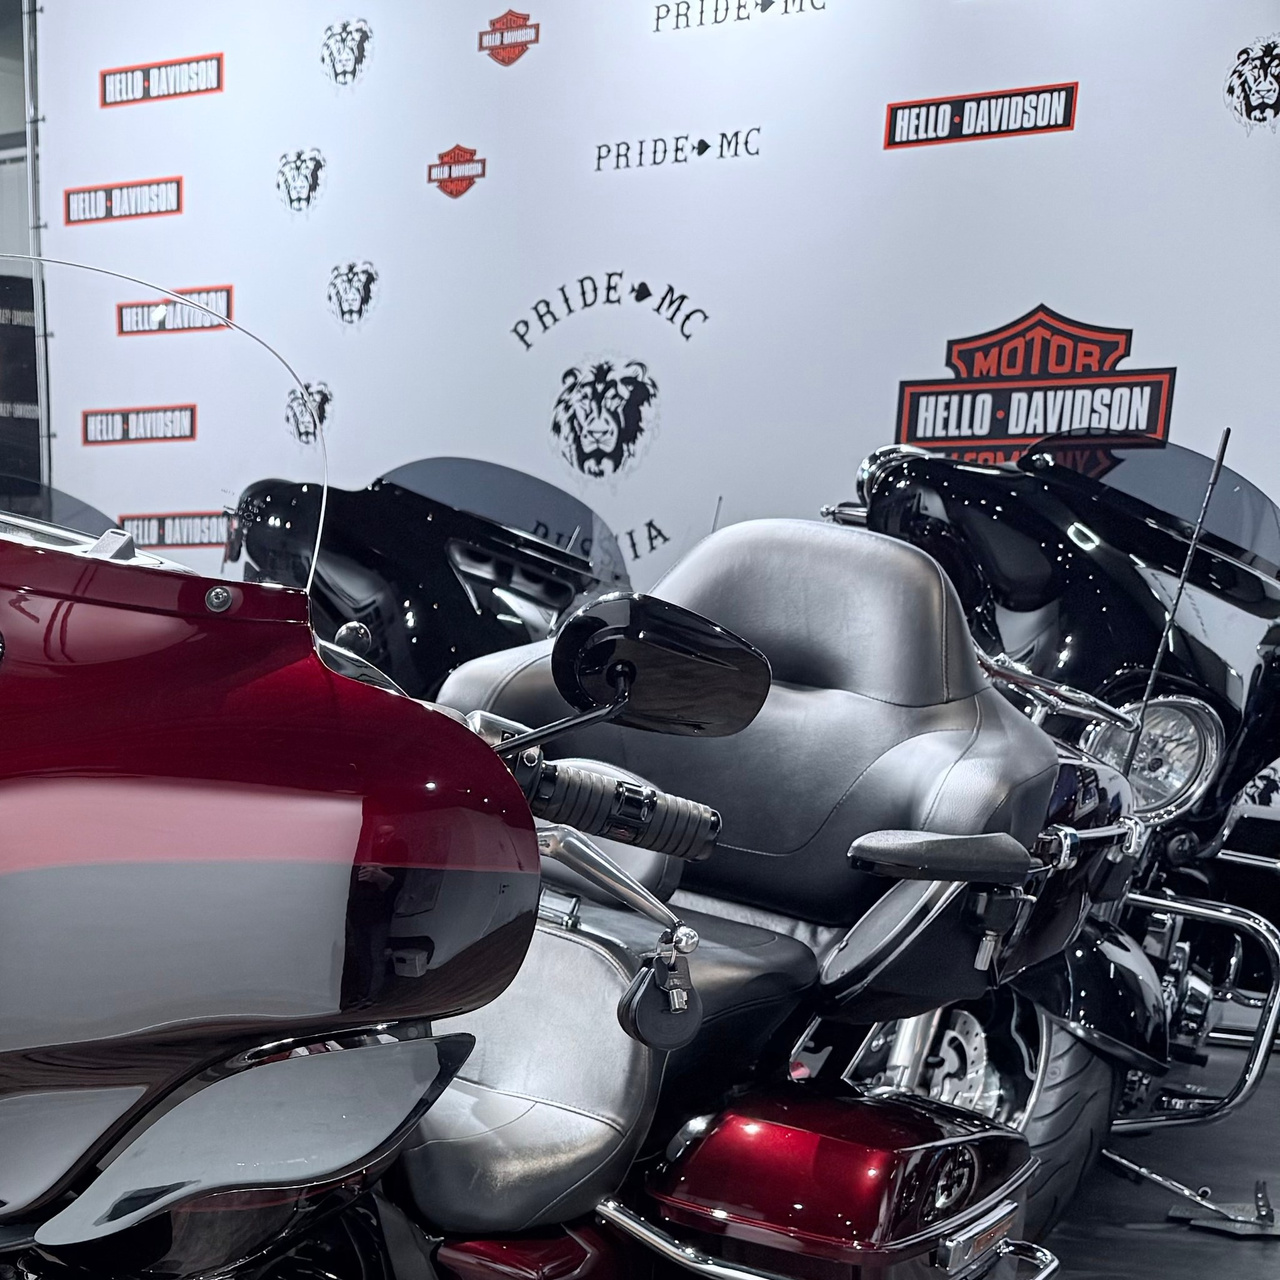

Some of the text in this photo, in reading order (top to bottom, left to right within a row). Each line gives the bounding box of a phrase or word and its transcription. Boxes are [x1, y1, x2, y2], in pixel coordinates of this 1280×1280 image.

[653, 0, 751, 33] PRIDE
[105, 58, 218, 104] HELLO DAVIDSON
[894, 90, 1067, 143] HELLO DAVIDSON
[594, 126, 762, 172] PRIDE MC
[69, 181, 178, 221] HELLO DAVIDSON
[510, 270, 710, 352] PRIDE MC
[972, 325, 1101, 378] MOTOR
[87, 408, 192, 441] HELLO DAVIDSON
[916, 386, 1152, 438] HELLO DAVIDSON
[164, 515, 228, 544] DAVIDSON
